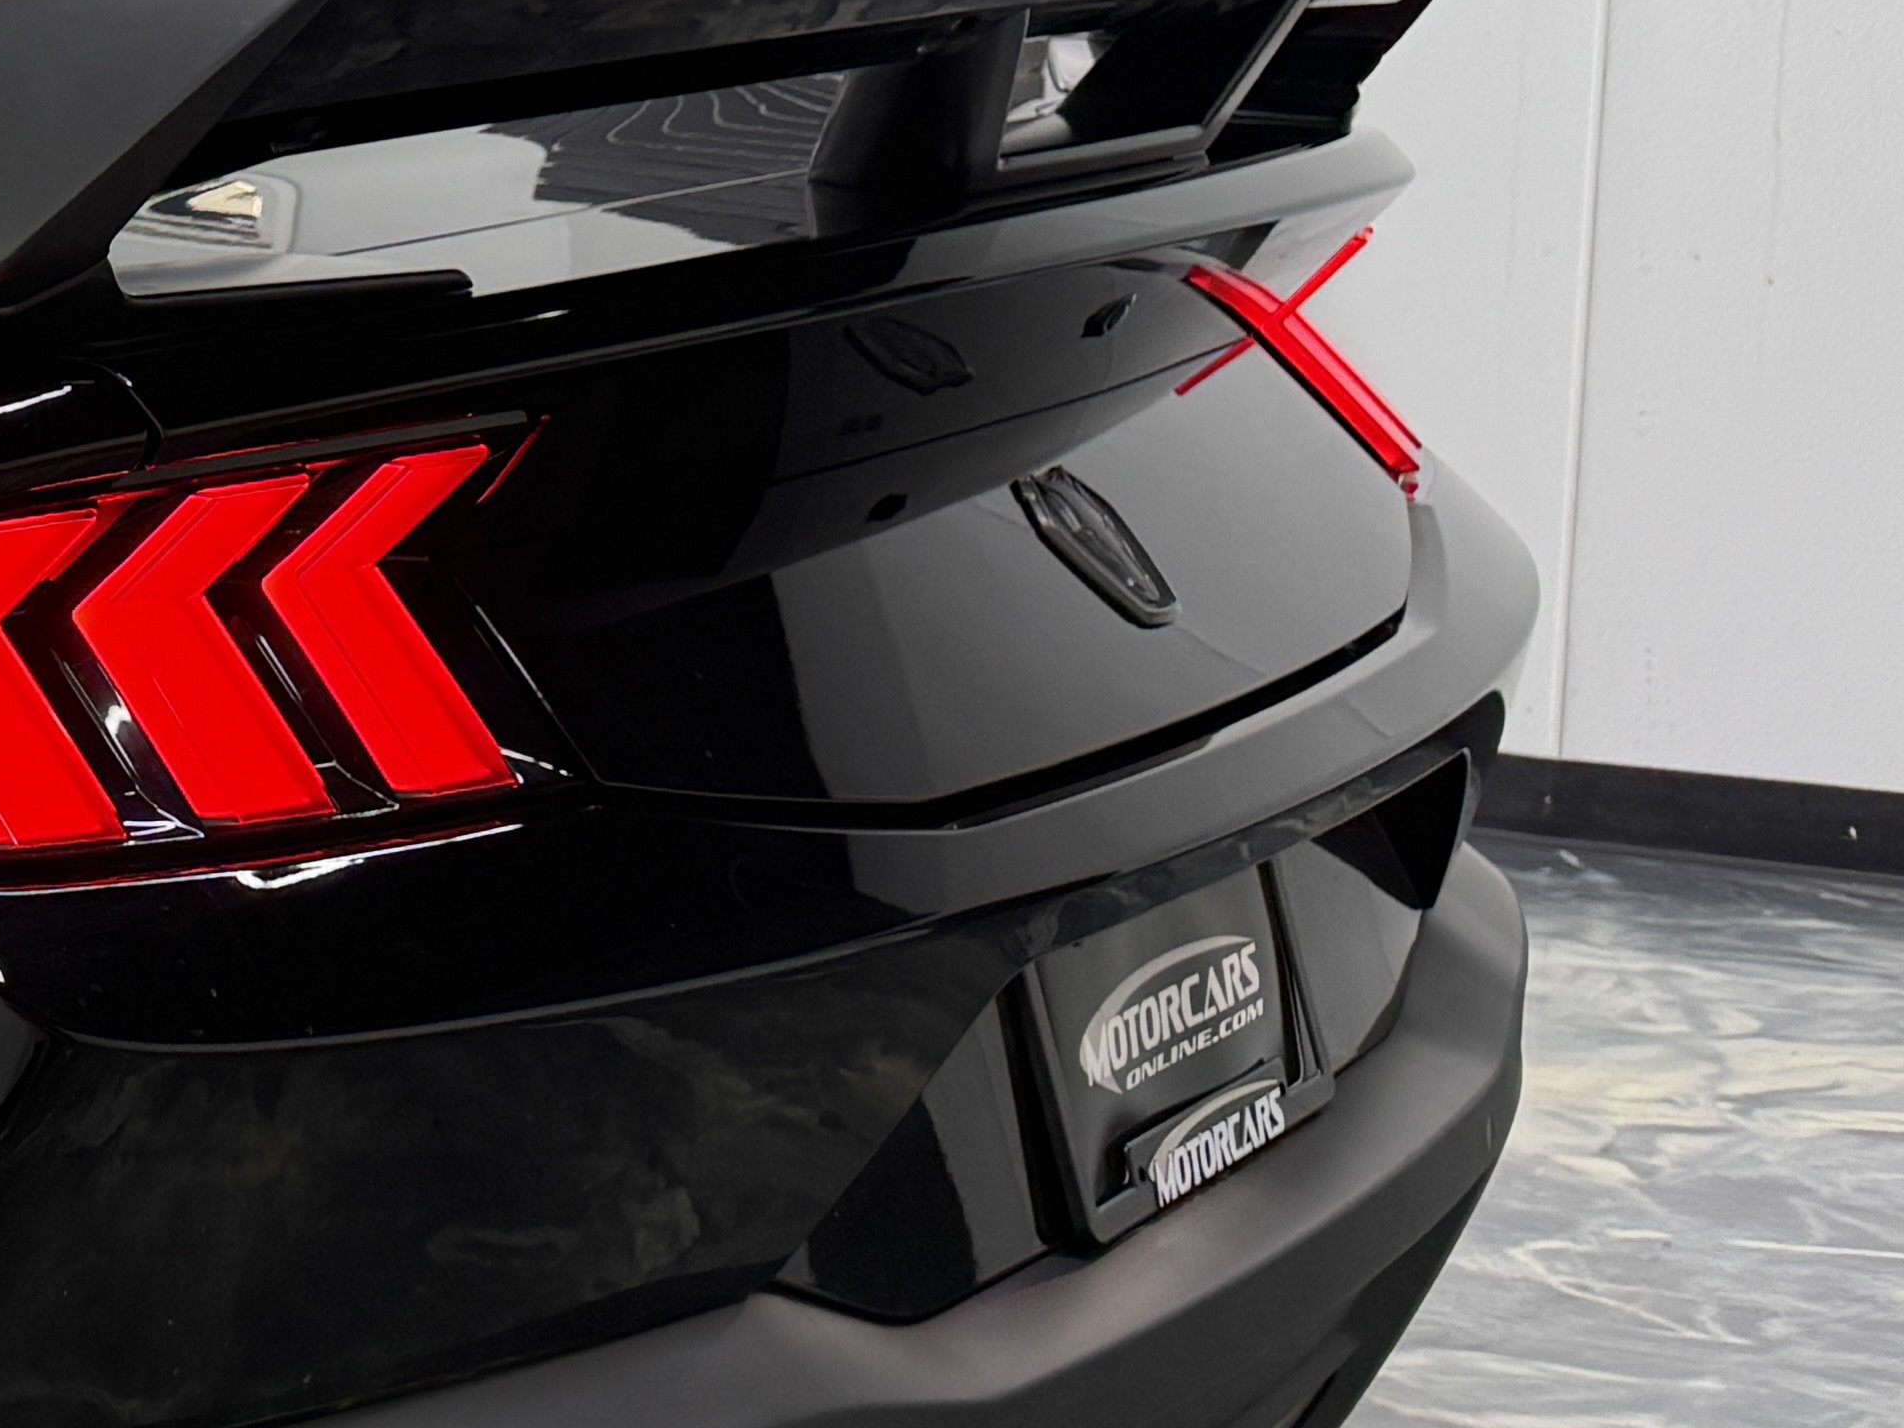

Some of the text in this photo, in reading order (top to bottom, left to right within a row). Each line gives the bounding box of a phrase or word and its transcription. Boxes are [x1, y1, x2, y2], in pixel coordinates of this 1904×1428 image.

[1087, 943, 1260, 1086] MOTORCARS
[1126, 999, 1264, 1090] ONLINE.COM
[1155, 1088, 1285, 1207] MOTORCARS
